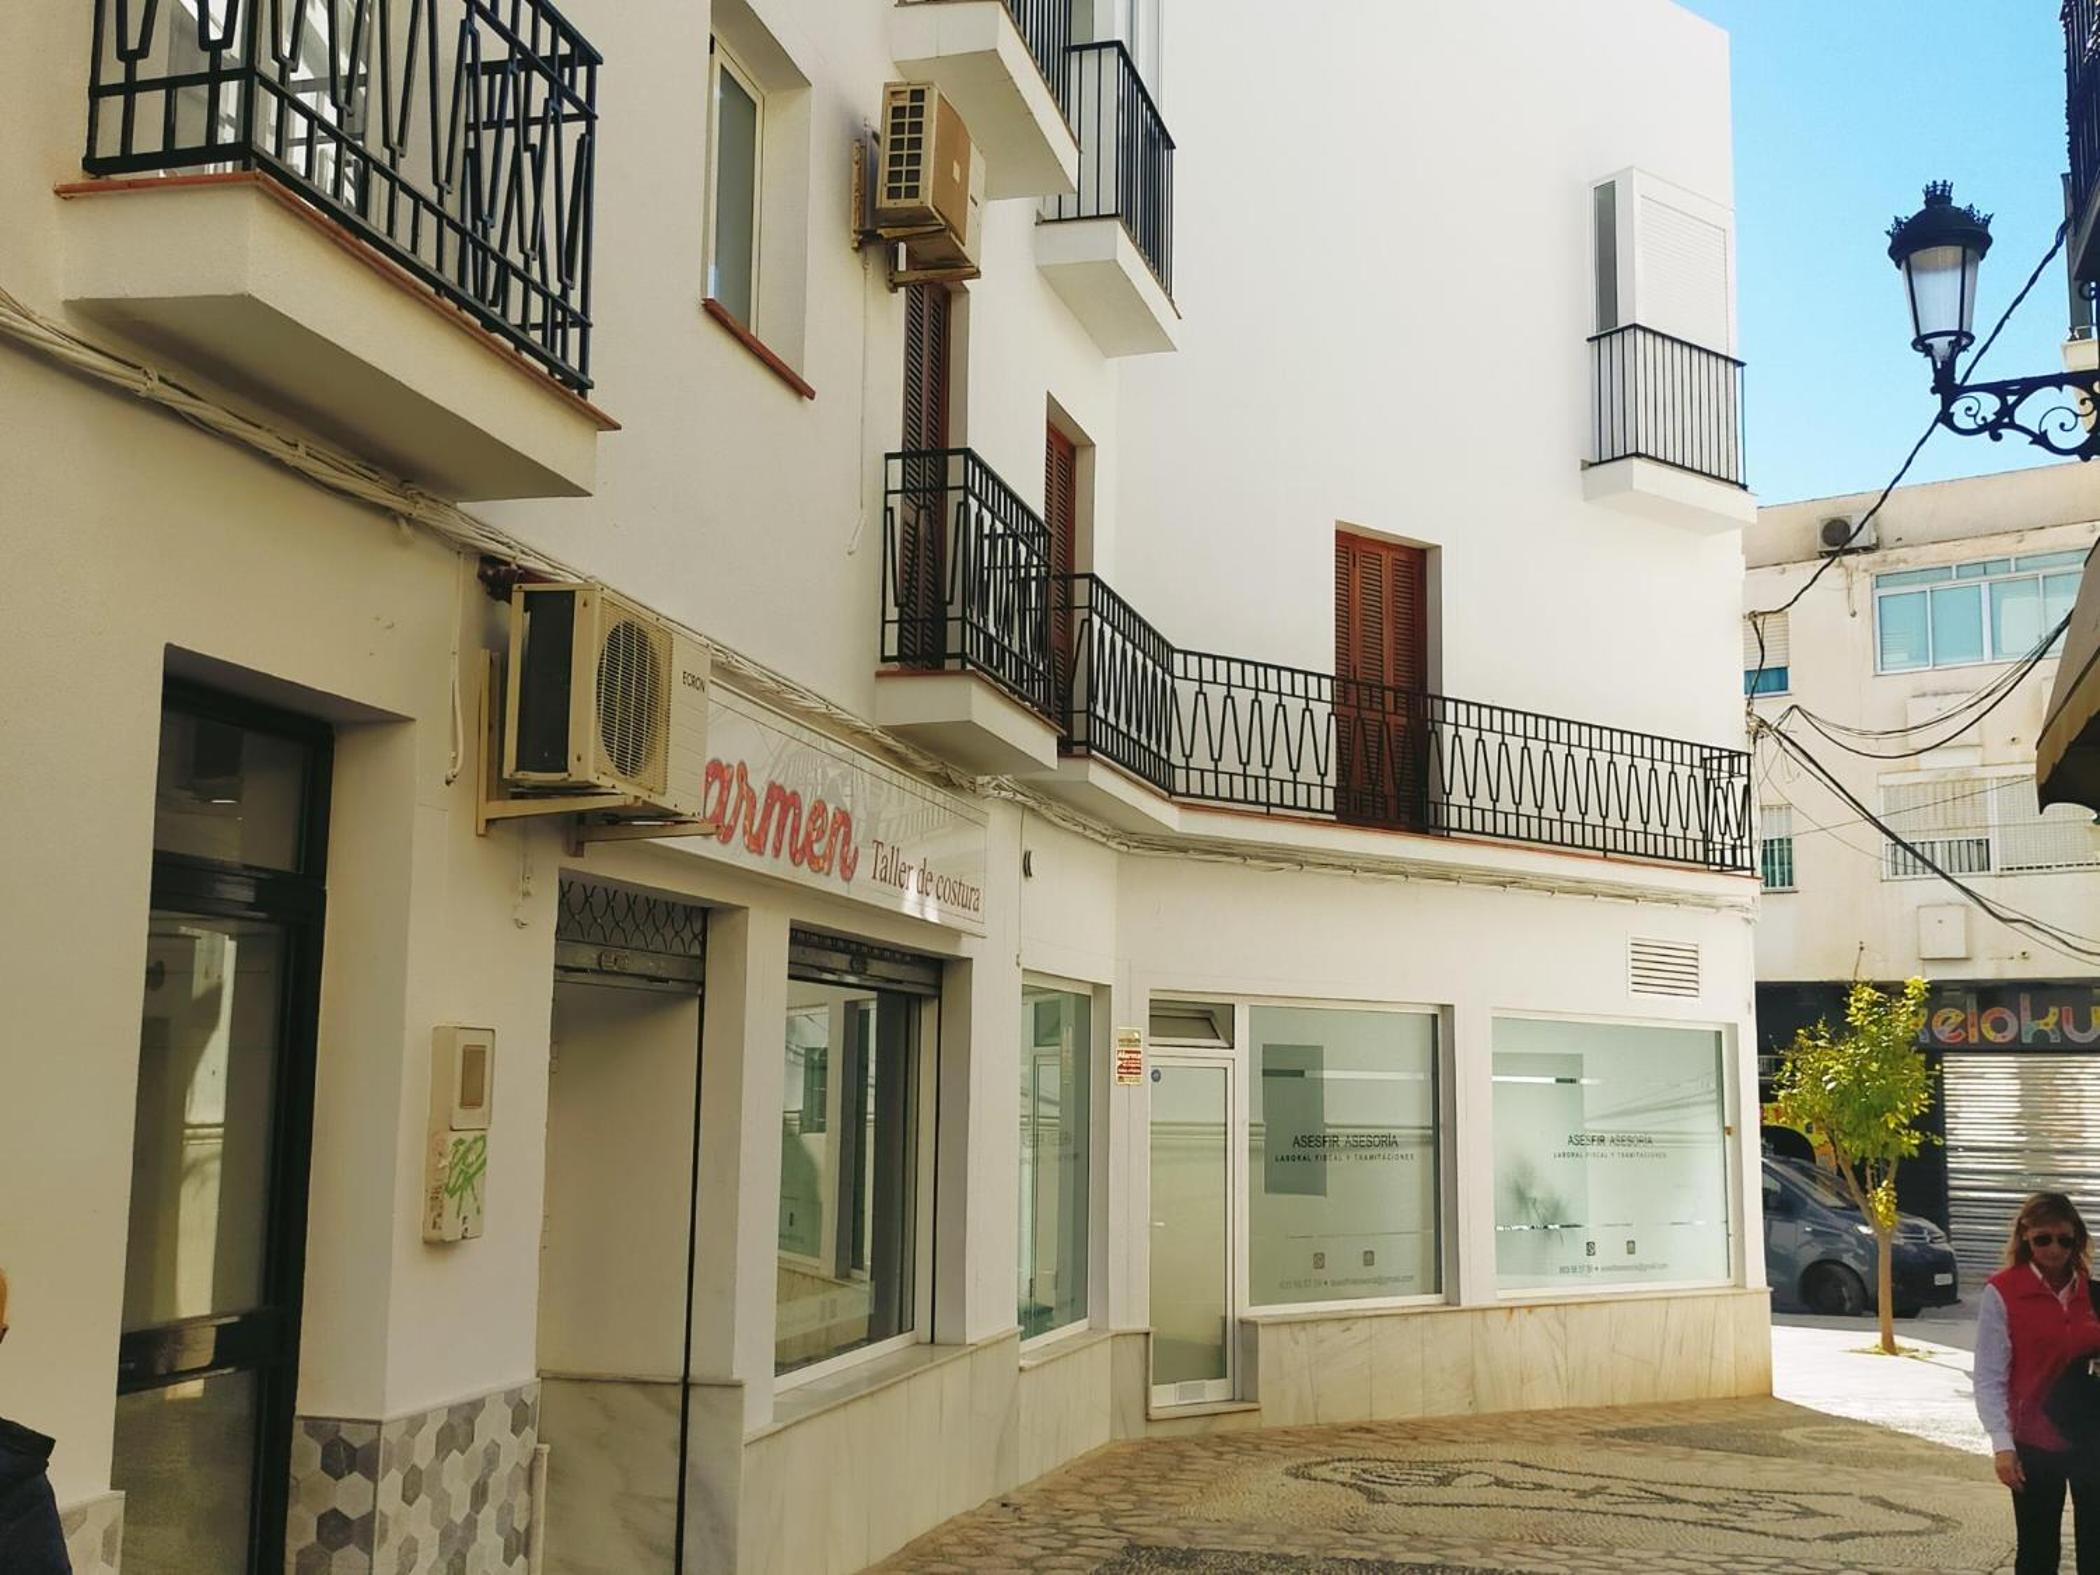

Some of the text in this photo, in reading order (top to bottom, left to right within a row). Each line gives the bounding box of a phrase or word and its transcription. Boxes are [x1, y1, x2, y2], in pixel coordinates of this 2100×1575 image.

[702, 759, 859, 882] armen
[872, 839, 981, 912] Taller de costura
[1292, 1132, 1399, 1148] ASESFIR ASESORÍA
[1567, 1134, 1606, 1146] ASESFIR
[1274, 1153, 1312, 1162] LABORAL
